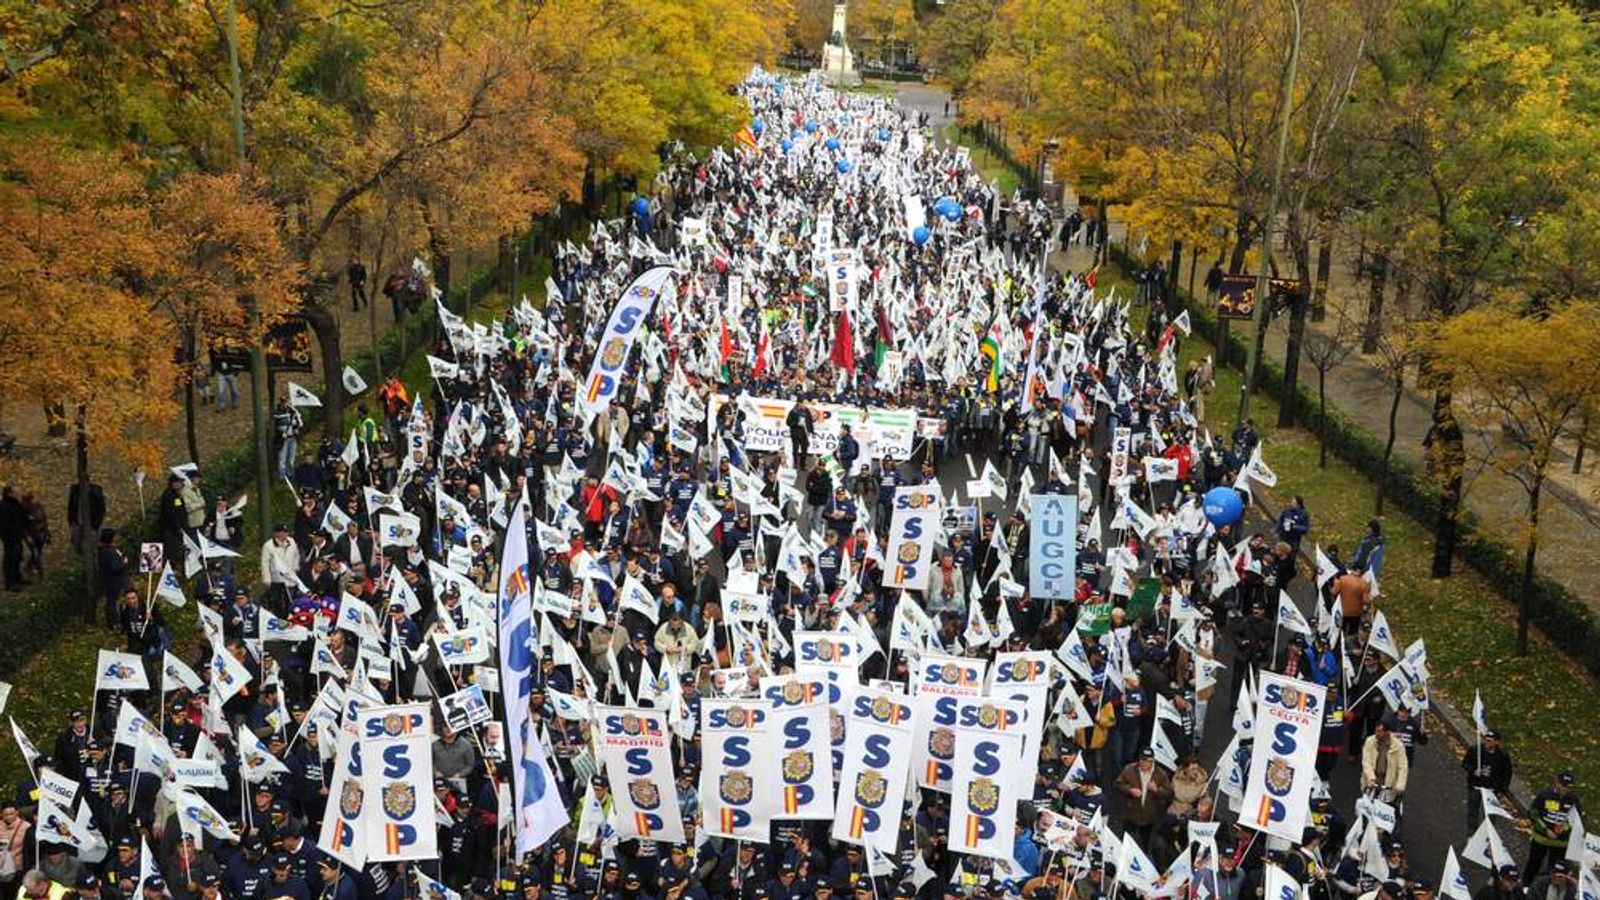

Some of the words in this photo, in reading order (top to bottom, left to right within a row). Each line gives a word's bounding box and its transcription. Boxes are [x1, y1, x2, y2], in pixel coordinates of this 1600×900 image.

[588, 306, 642, 404] SUP
[896, 492, 936, 511] SUP
[895, 516, 923, 585] SUP
[1040, 500, 1064, 579] AUGC
[801, 639, 851, 662] SUP
[925, 662, 978, 687] SUP
[997, 657, 1046, 682] SUP
[765, 680, 824, 708] SUP
[1265, 683, 1318, 709] SUP
[709, 706, 765, 729] SUP
[853, 696, 911, 725] SUP
[960, 704, 1018, 731] SUP
[1269, 708, 1309, 725] CEUTA
[366, 712, 423, 738] SUP
[605, 713, 660, 737] SUP
[606, 737, 664, 747] MADRID
[782, 717, 814, 814] SUP
[1257, 722, 1298, 827] SUP
[625, 748, 664, 836] SUP
[719, 736, 756, 834] SUP
[849, 734, 891, 840] SUP
[965, 741, 1000, 848] SUP
[382, 744, 417, 855] SUP
